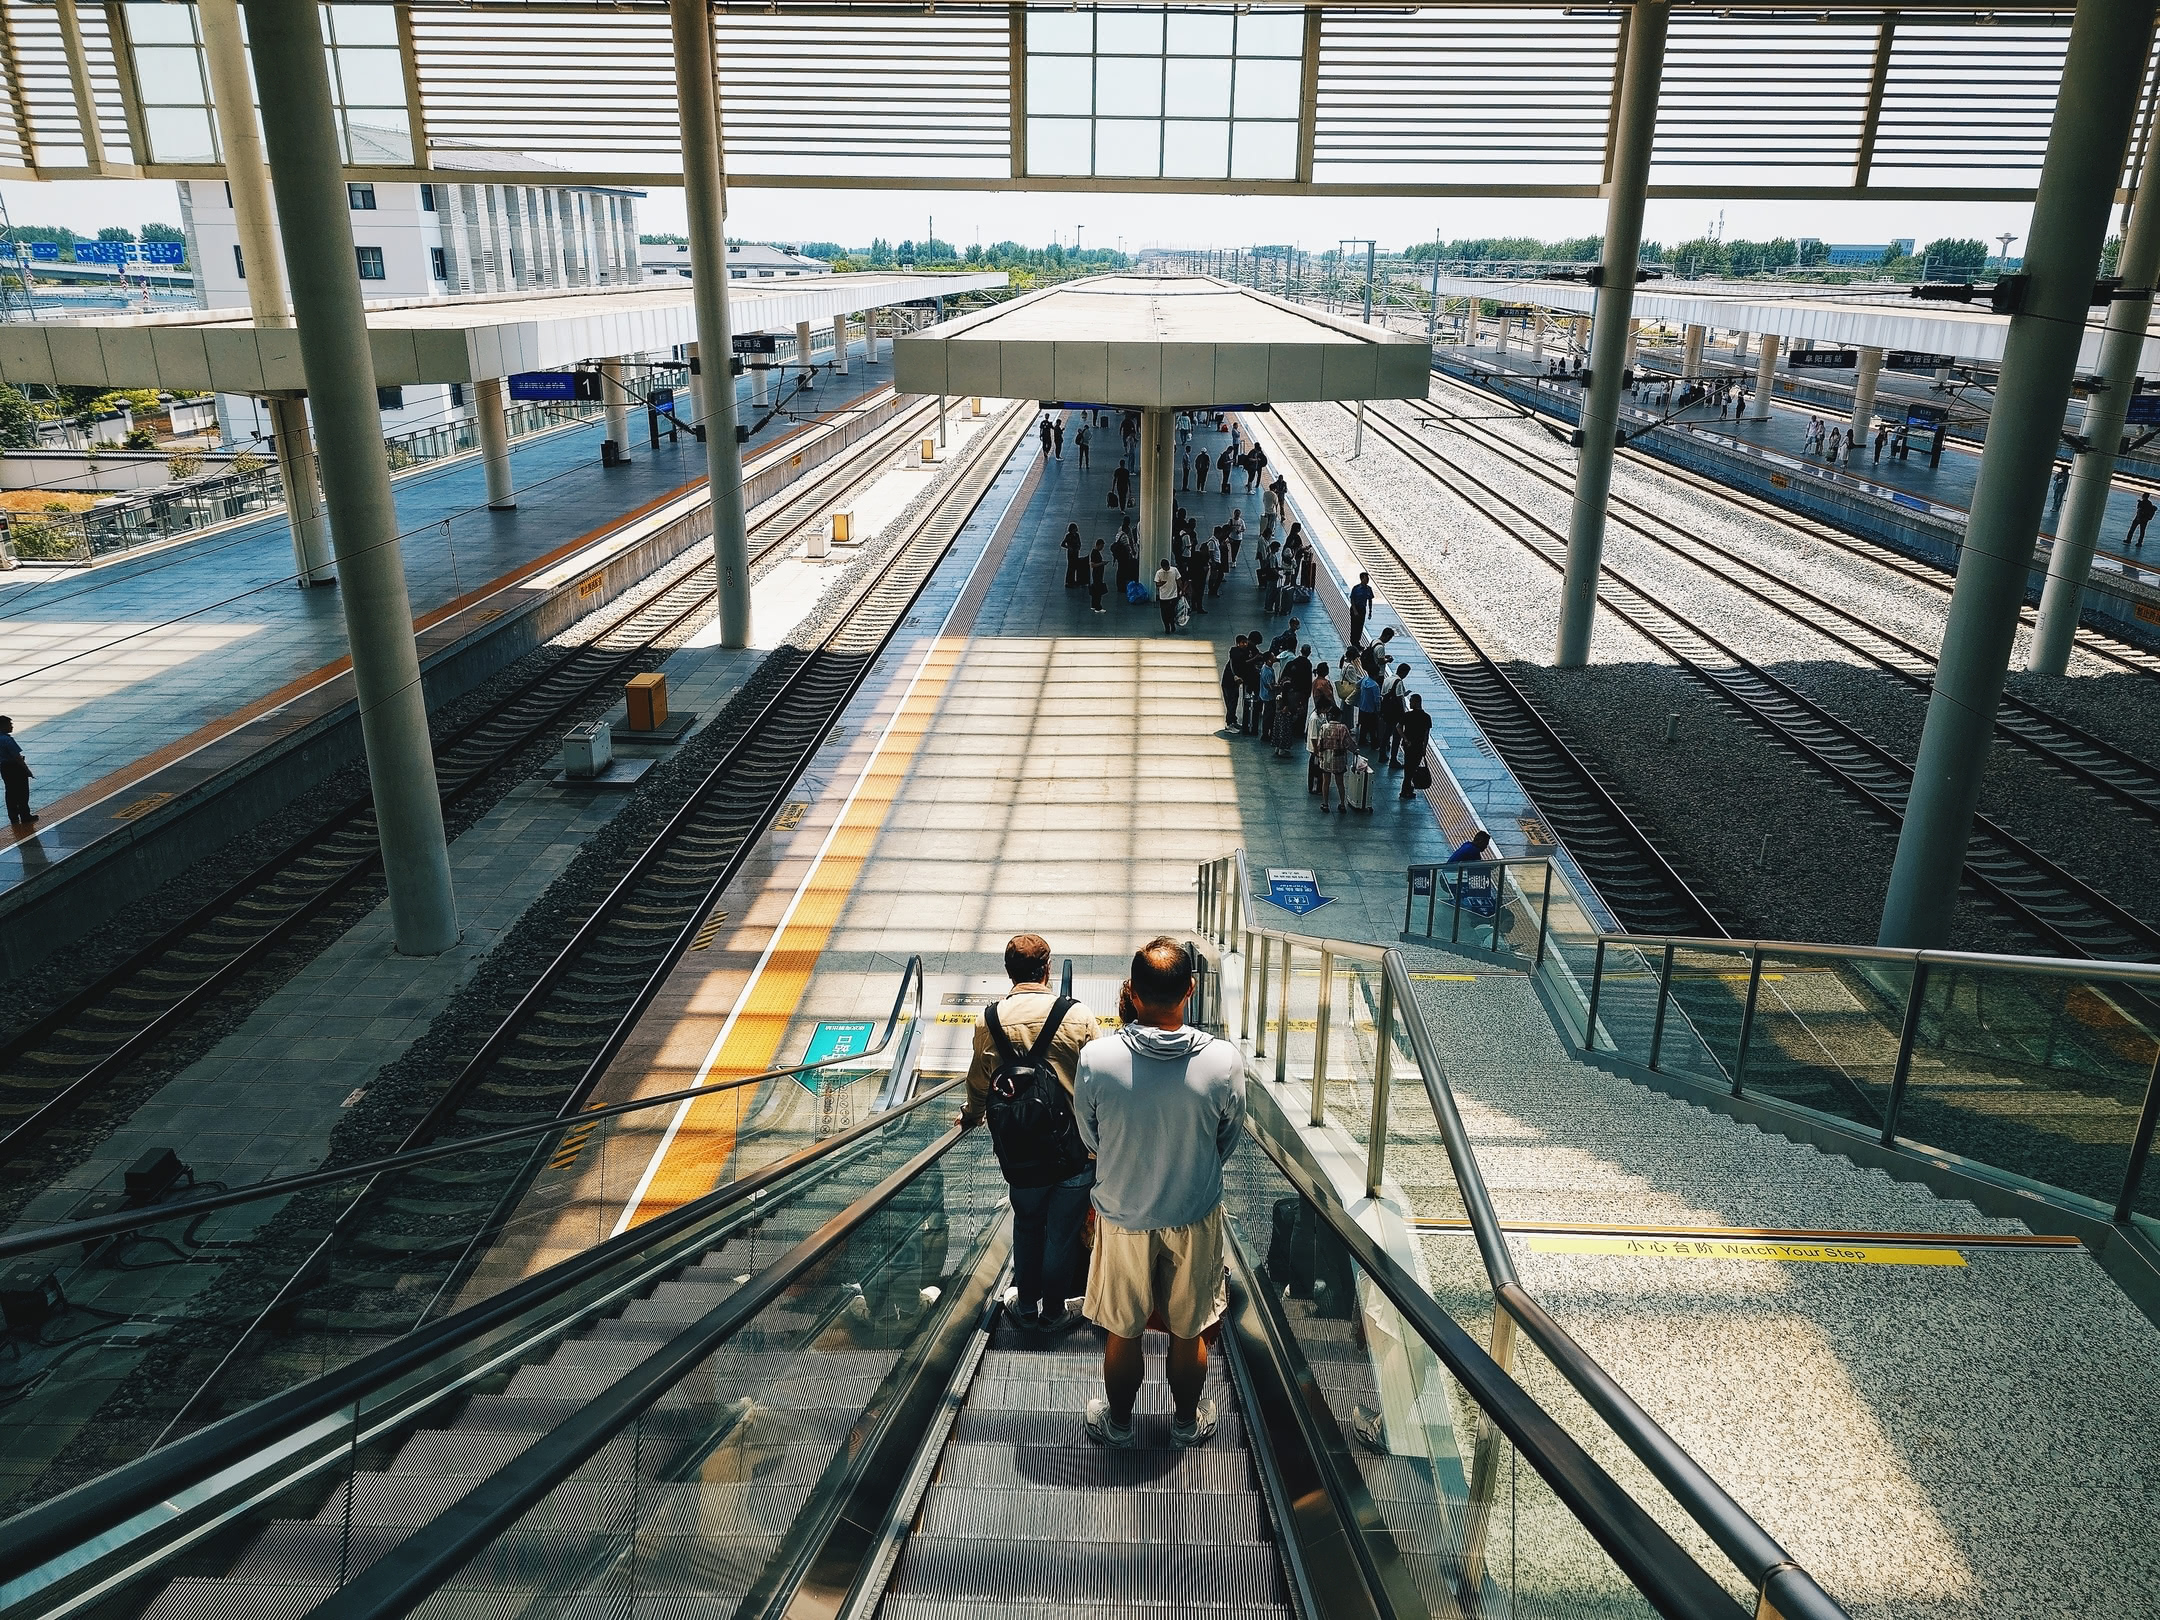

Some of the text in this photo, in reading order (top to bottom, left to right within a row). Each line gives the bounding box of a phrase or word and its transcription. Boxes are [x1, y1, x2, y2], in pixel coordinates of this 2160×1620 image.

[733, 339, 761, 348] 阳西站
[1805, 354, 1842, 363] 阜阳西站
[582, 378, 591, 396] 1
[1627, 1240, 1867, 1261] 小心台阶 Watch Your Step
